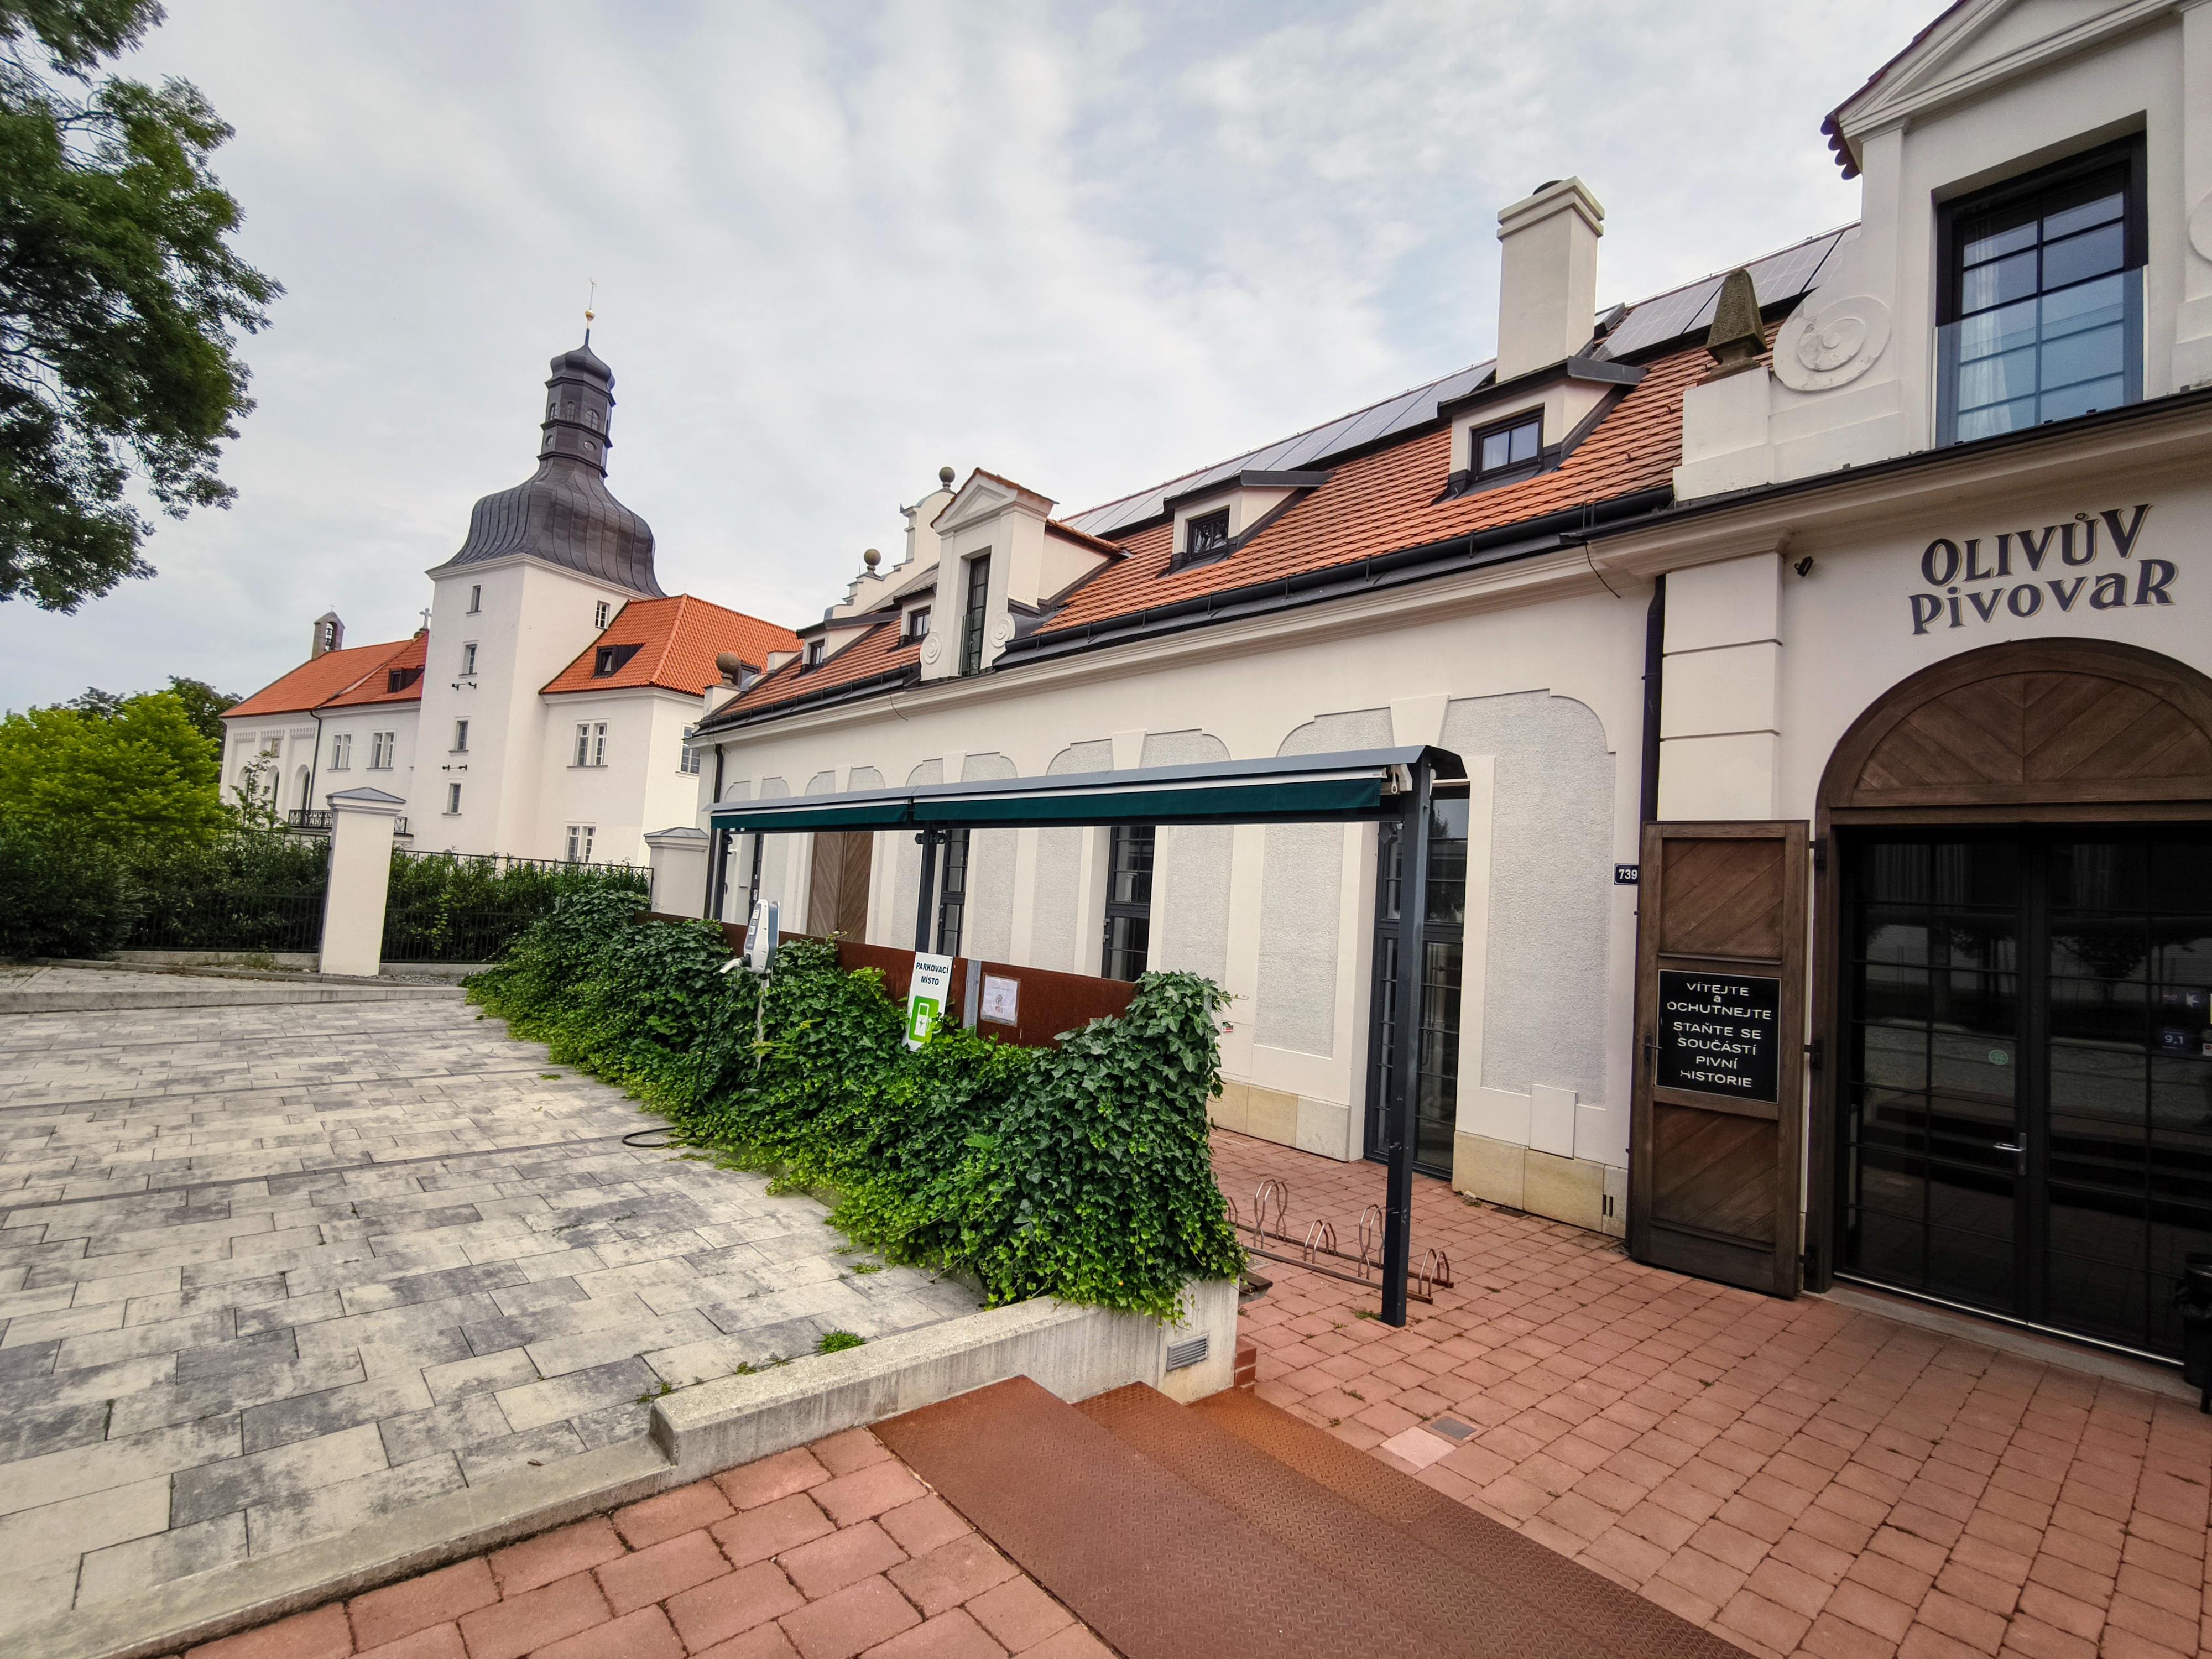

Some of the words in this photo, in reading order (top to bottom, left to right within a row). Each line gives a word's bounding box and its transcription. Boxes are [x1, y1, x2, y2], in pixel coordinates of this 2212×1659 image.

[1921, 504, 2152, 586] OLIVŮV
[1618, 869, 1637, 880] 739
[916, 962, 949, 974] PARKOVACÍ
[921, 975, 939, 985] MÍSTO
[1686, 982, 1749, 996] VÍTEJTE
[1667, 1001, 1771, 1020] OCHUTNEJTE
[1673, 1022, 1733, 1037] STAŇTE
[1740, 1029, 1761, 1039] SE
[1677, 1037, 1756, 1055] SOUČÁSTÍ
[2164, 1035, 2184, 1045] 9.1
[1695, 1056, 1738, 1069] PIVNÍ
[1681, 1070, 1752, 1087] HISTORIE
